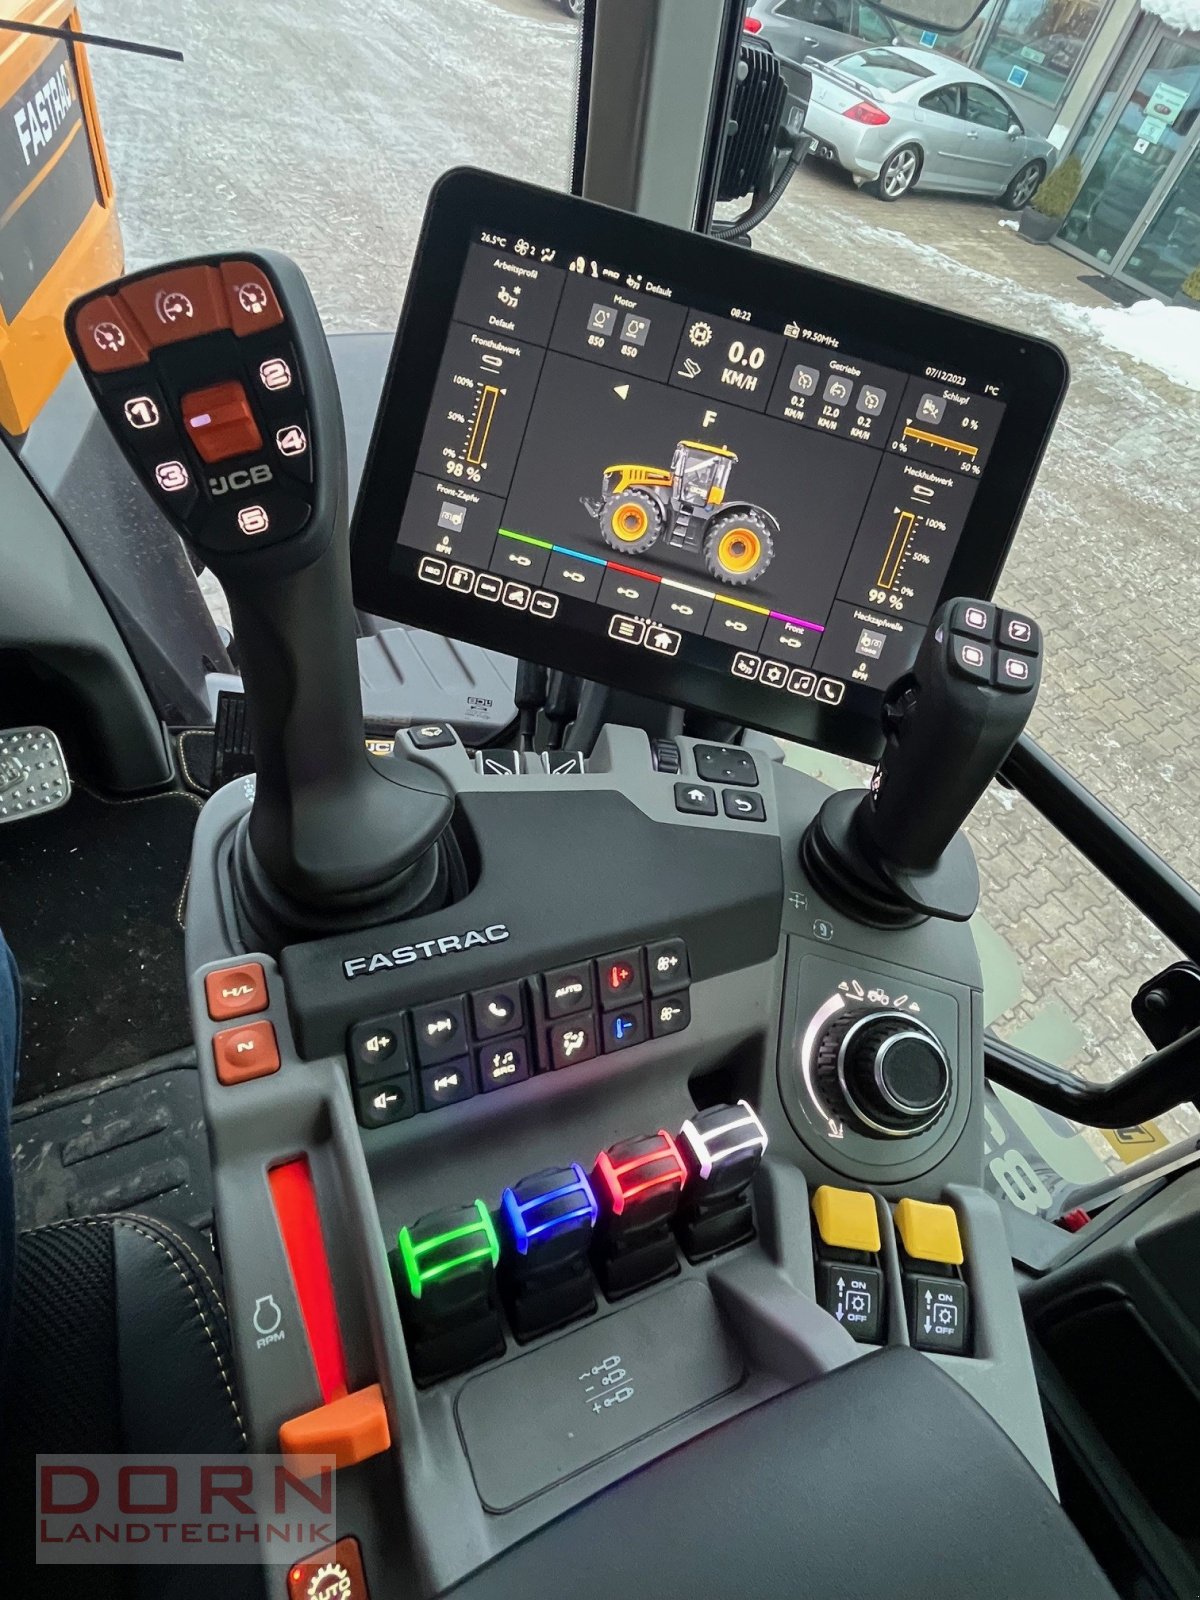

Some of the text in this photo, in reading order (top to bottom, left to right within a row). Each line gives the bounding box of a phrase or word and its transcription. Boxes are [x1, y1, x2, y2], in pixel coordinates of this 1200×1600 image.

[13, 63, 72, 166] FASTRAC
[480, 232, 507, 247] 26.5°C
[493, 259, 538, 279] Arbeitsprofil
[645, 281, 672, 298] Default
[613, 294, 637, 308] Motor
[488, 315, 515, 330] Default
[470, 334, 521, 356] Fronthubwerk
[588, 335, 605, 348] 850
[802, 328, 839, 348] 99.50MHz
[621, 345, 638, 358] 850
[728, 341, 765, 369] 0.0
[829, 360, 861, 377] Getriebe
[925, 366, 967, 386] 07/12/2023
[266, 367, 285, 386] 2
[453, 375, 474, 388] 100%
[720, 368, 758, 391] KM/H
[790, 396, 805, 408] 0.2
[943, 390, 970, 406] Schlupf
[131, 402, 151, 423] 1
[447, 411, 465, 423] 50%
[702, 410, 717, 428] F
[784, 407, 804, 421] KM/H
[822, 405, 840, 418] 12.0
[817, 417, 838, 430] KM/H
[857, 416, 872, 428] 0.2
[282, 431, 302, 451] 4
[850, 427, 871, 440] KM/H
[160, 465, 182, 487] 3
[446, 460, 464, 477] 98
[903, 465, 954, 487] Heckhubwerk
[209, 464, 273, 495] JCB
[243, 513, 263, 530] 5
[925, 518, 947, 532] 100%
[912, 552, 930, 565] 50%
[868, 588, 887, 605] 99
[784, 622, 804, 636] Front
[344, 924, 509, 977] FASTRAC
[222, 985, 253, 998] H/L
[555, 983, 583, 998] AUTO
[237, 1040, 254, 1053] N
[851, 1280, 866, 1290] ON
[938, 1293, 953, 1303] ON
[847, 1313, 867, 1323] OFF
[935, 1326, 955, 1335] OFF
[256, 1330, 285, 1349] RPM
